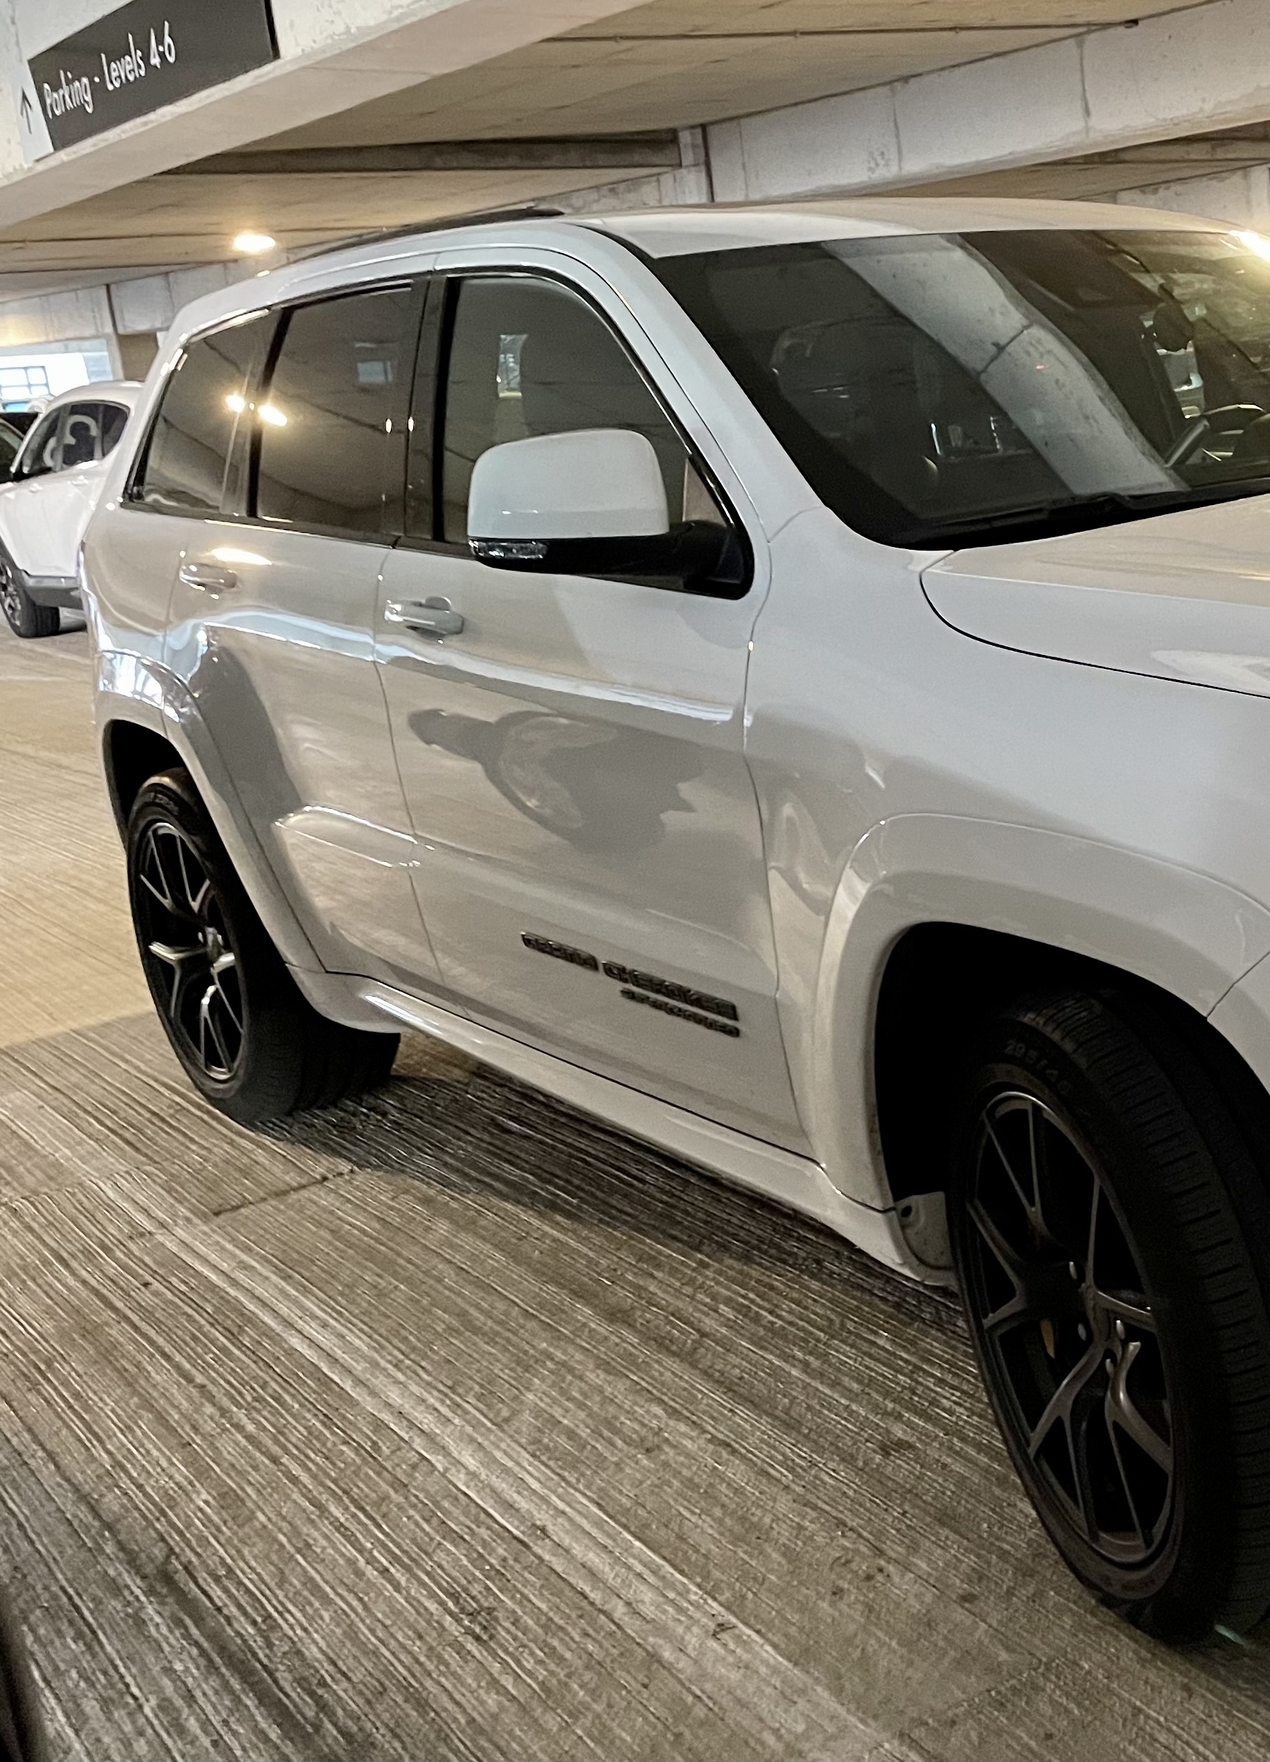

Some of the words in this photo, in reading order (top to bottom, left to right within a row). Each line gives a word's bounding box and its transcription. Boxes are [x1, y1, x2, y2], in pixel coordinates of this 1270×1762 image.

[43, 69, 94, 119] Parking
[101, 31, 146, 91] Levels
[150, 20, 176, 69] 4-6
